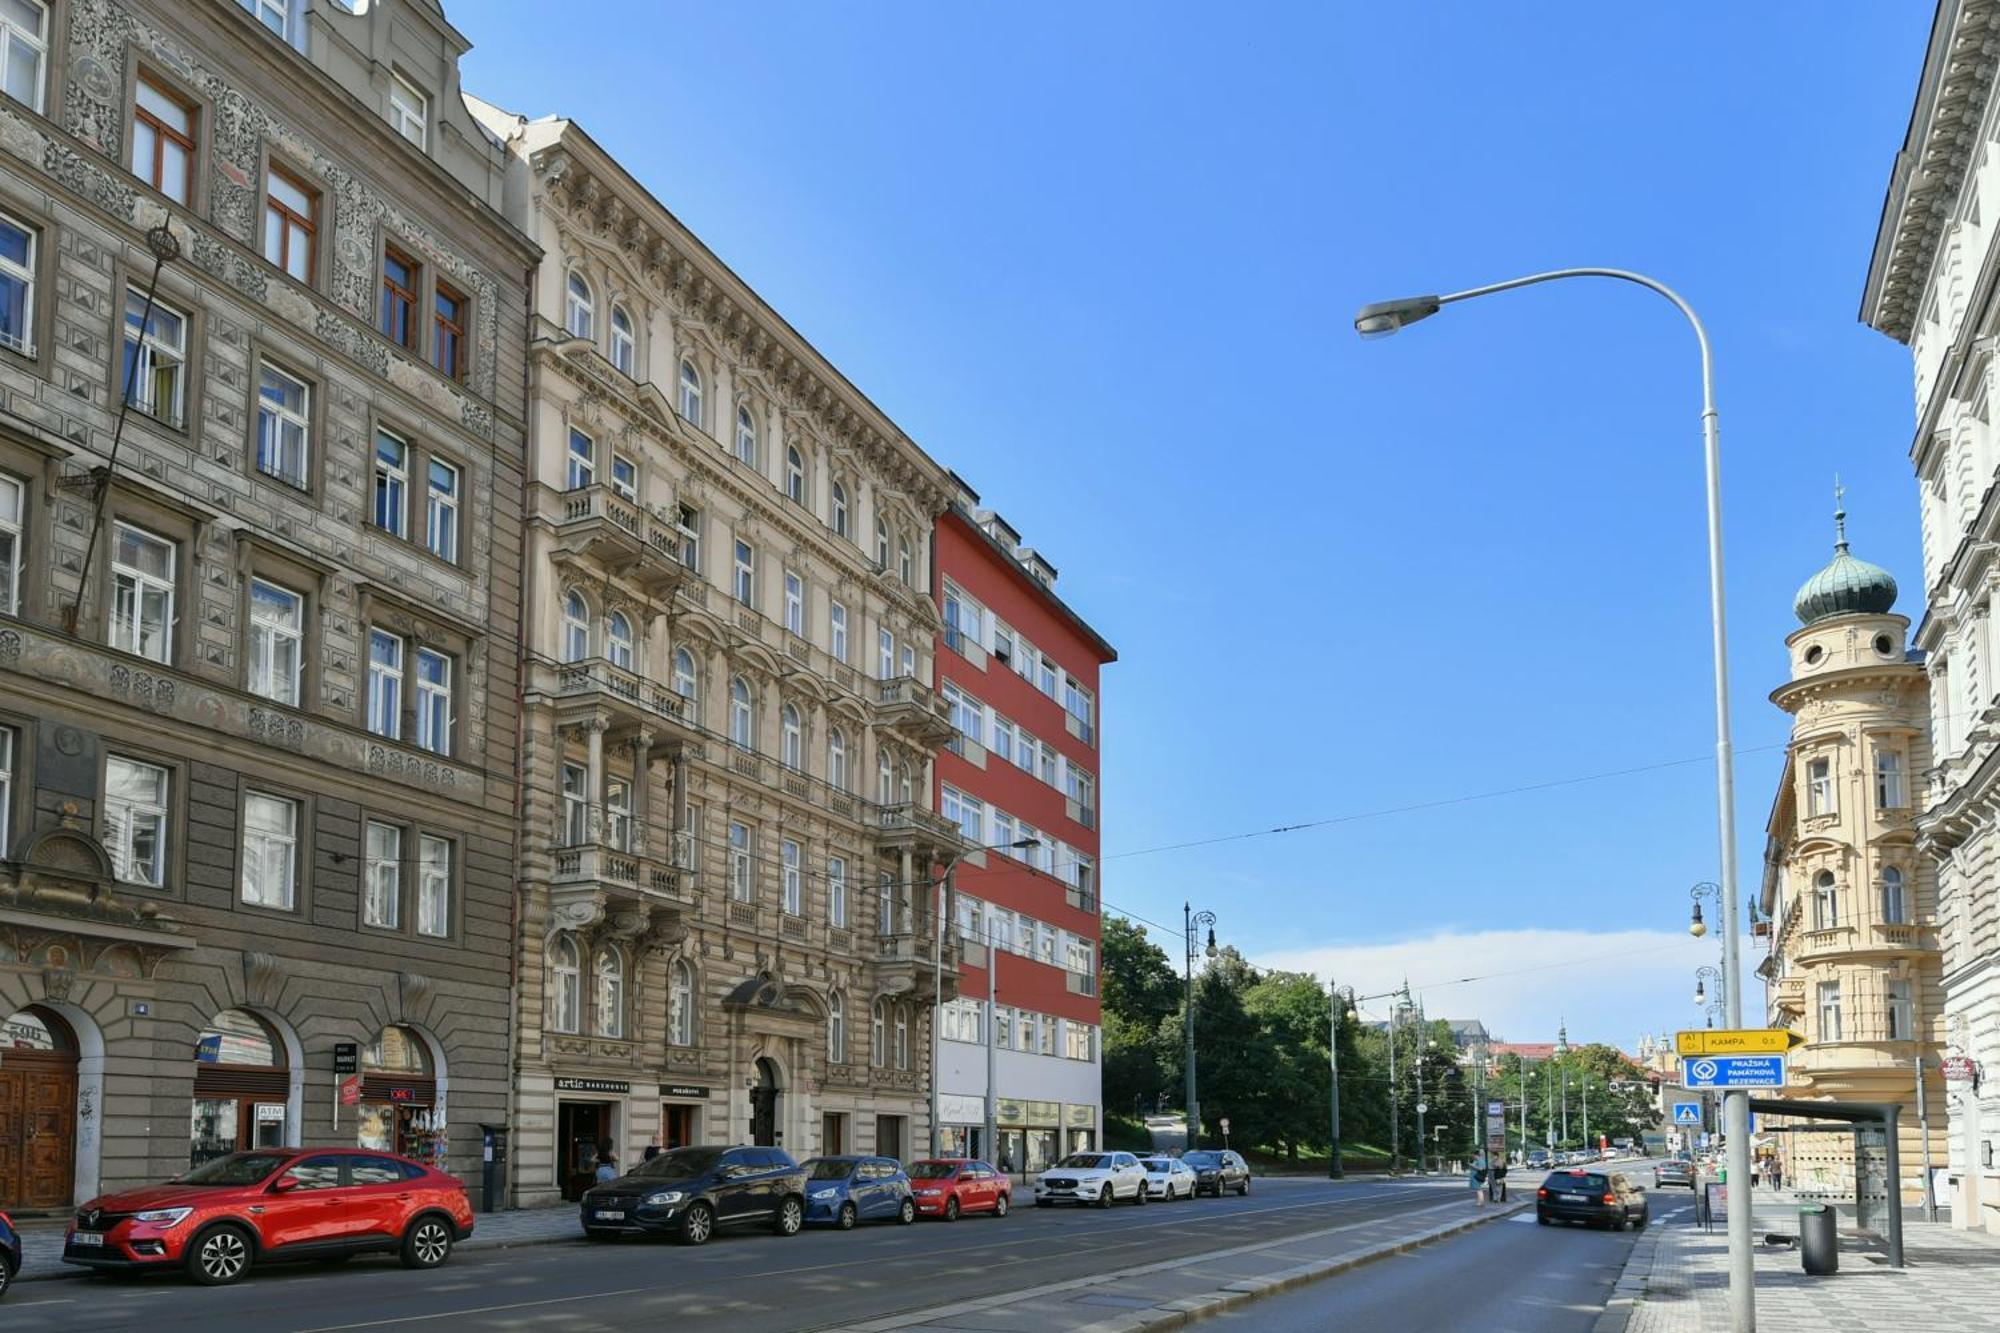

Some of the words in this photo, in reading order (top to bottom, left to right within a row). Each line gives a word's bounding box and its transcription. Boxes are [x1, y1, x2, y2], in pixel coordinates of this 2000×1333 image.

[1711, 1037, 1745, 1046] KAMPA
[1731, 1059, 1770, 1067] PRAŽSKÁ
[1727, 1068, 1775, 1076] PAMÁTKOVÁ
[558, 1077, 584, 1089] artic
[259, 1107, 283, 1116] ATM
